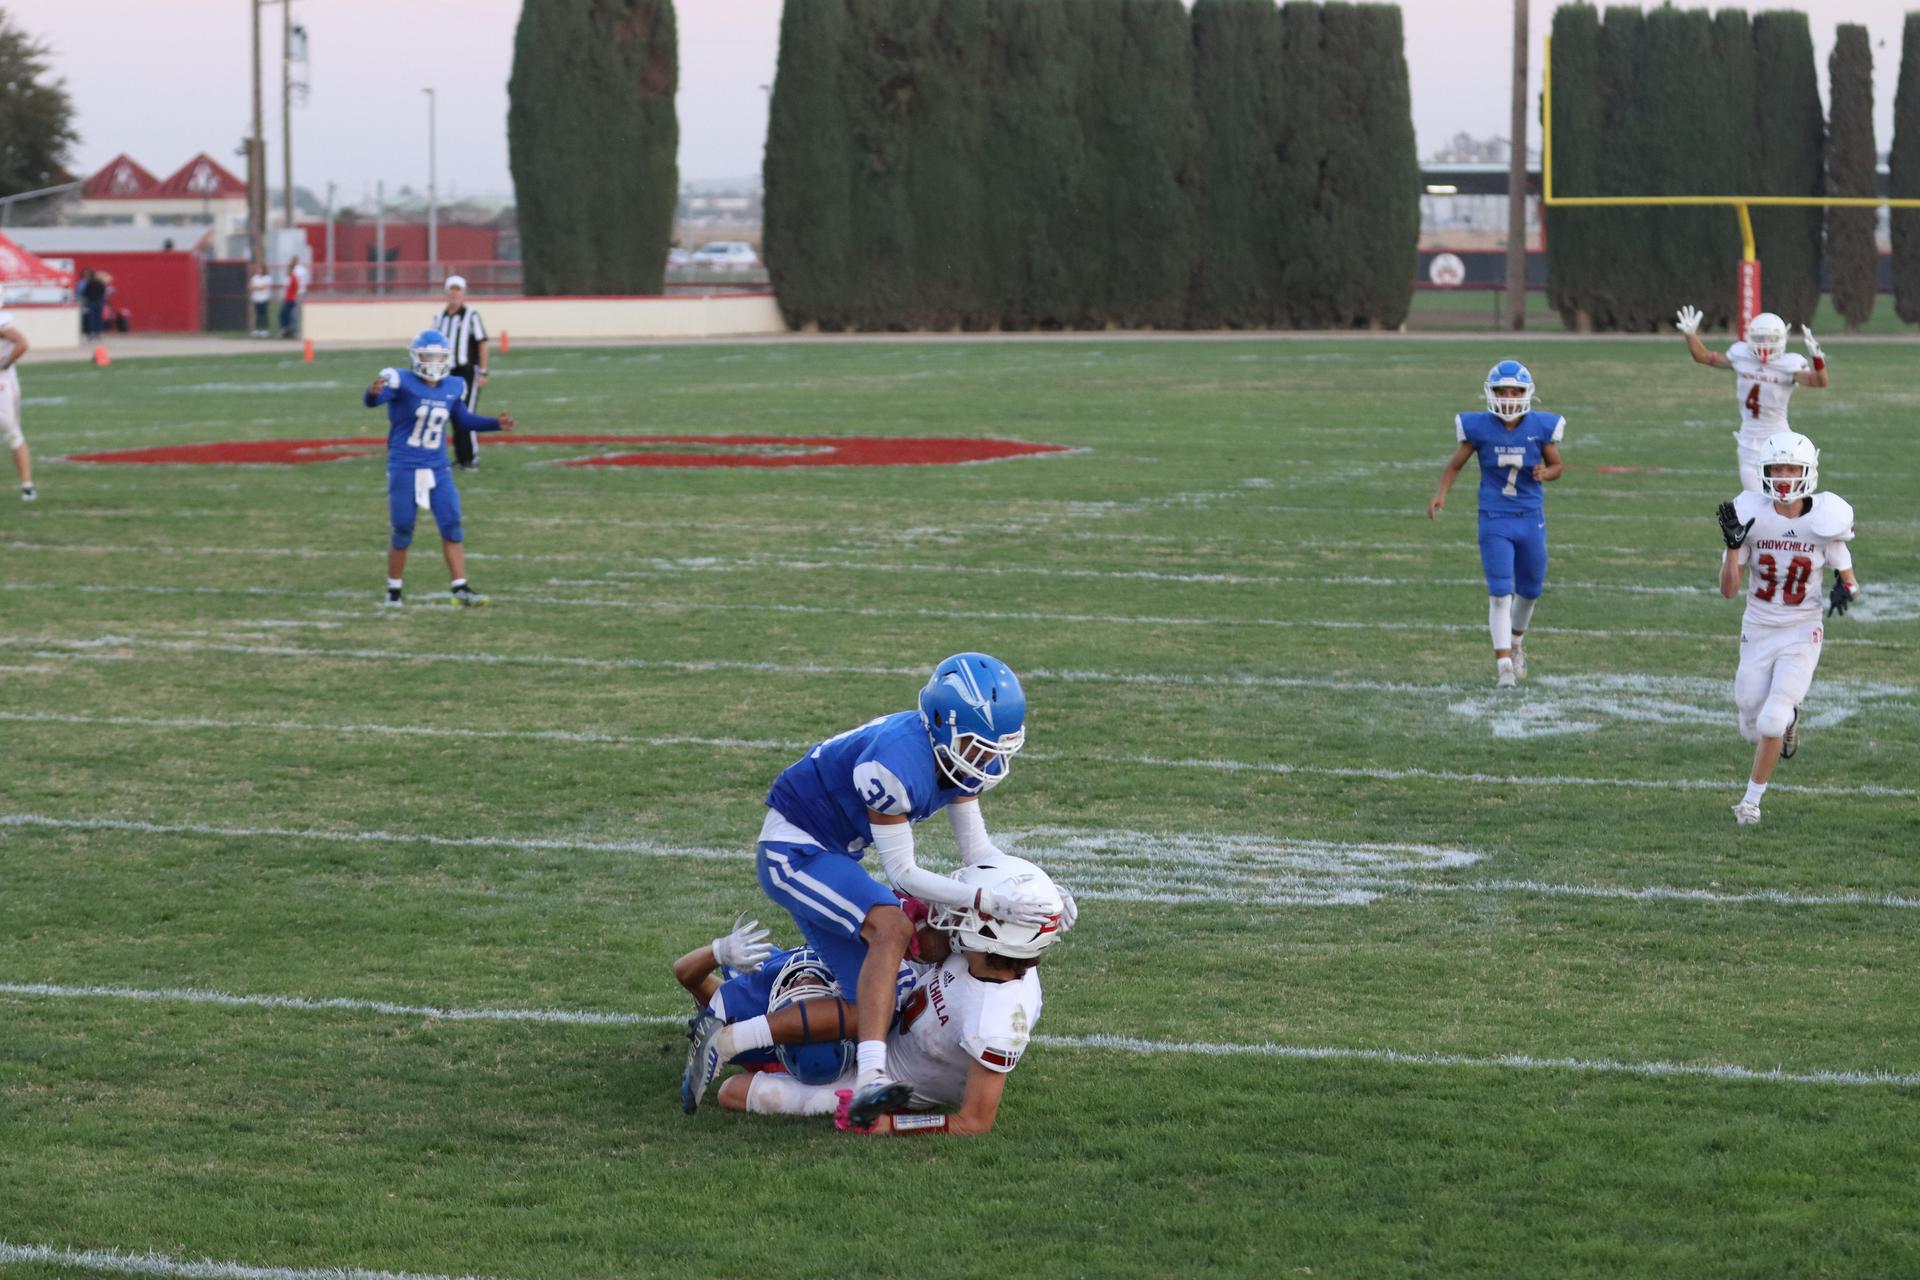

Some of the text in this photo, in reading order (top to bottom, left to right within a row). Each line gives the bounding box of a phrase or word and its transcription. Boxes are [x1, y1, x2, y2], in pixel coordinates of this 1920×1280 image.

[1745, 384, 1761, 418] 4
[407, 405, 450, 449] 18
[1497, 454, 1523, 496] 7
[1756, 540, 1815, 553] CHOWCHILLA
[1754, 554, 1812, 606] 30
[866, 778, 896, 812] 31
[688, 1016, 713, 1065] VAPOR
